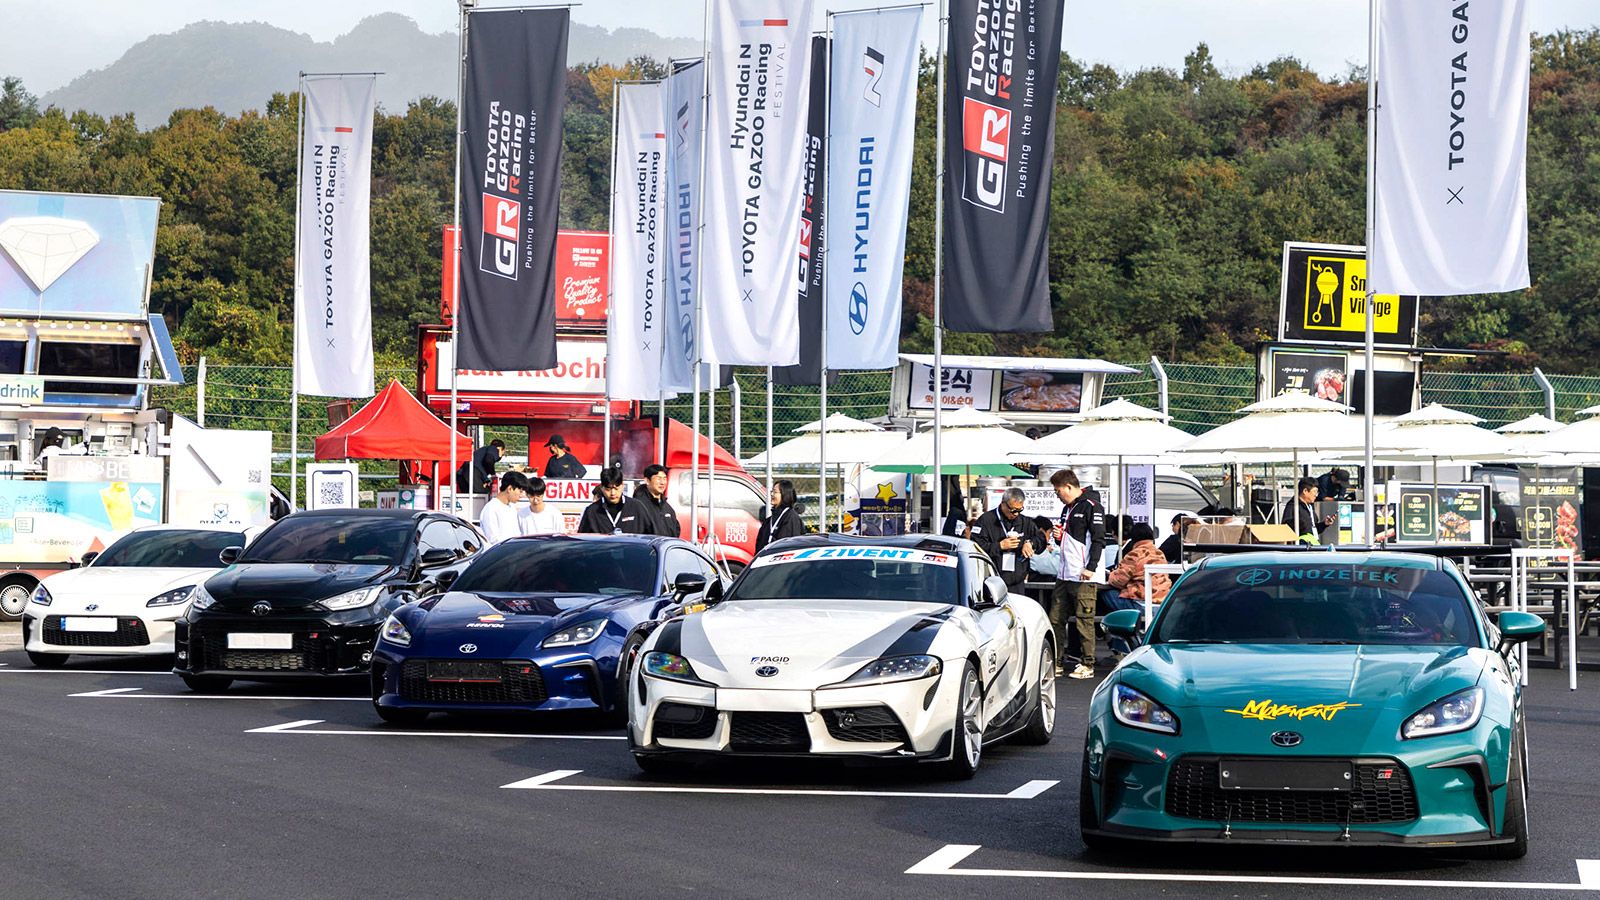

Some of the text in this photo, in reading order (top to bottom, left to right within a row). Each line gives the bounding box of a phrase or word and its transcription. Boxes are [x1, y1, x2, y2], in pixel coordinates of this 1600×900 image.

[754, 44, 771, 111] Racing
[1027, 40, 1036, 60] for
[730, 44, 752, 149] Hyundai N
[774, 43, 787, 118] FESTIVAL
[1024, 69, 1035, 108] limits
[1021, 114, 1032, 136] the
[1448, 51, 1468, 171] TOYOTA
[314, 145, 323, 156] N
[325, 145, 340, 198] Racing
[484, 101, 500, 188] TOYOTA
[497, 110, 511, 192] GAZOO
[508, 114, 526, 195] Racing
[748, 116, 764, 189] GAZOO
[977, 108, 1008, 207] GR
[1016, 144, 1032, 198] Pushing
[636, 152, 647, 233] Hyundai N
[650, 152, 660, 203] Racing
[853, 136, 875, 273] HYUNDAI
[324, 202, 334, 260] GAZOO
[495, 200, 518, 275] GR
[525, 228, 534, 269] Pushing
[647, 207, 657, 264] GAZOO
[742, 194, 760, 277] TOYOTA
[564, 285, 598, 299] Quality
[813, 246, 824, 286] Pushing
[325, 264, 334, 328] TOYOTA
[566, 293, 603, 309] Product
[644, 268, 654, 332] TOYOTA
[0, 384, 39, 398] drink
[725, 534, 748, 542] FOOD
[820, 548, 915, 559] ZIVENT
[1279, 569, 1399, 584] INOZETEK
